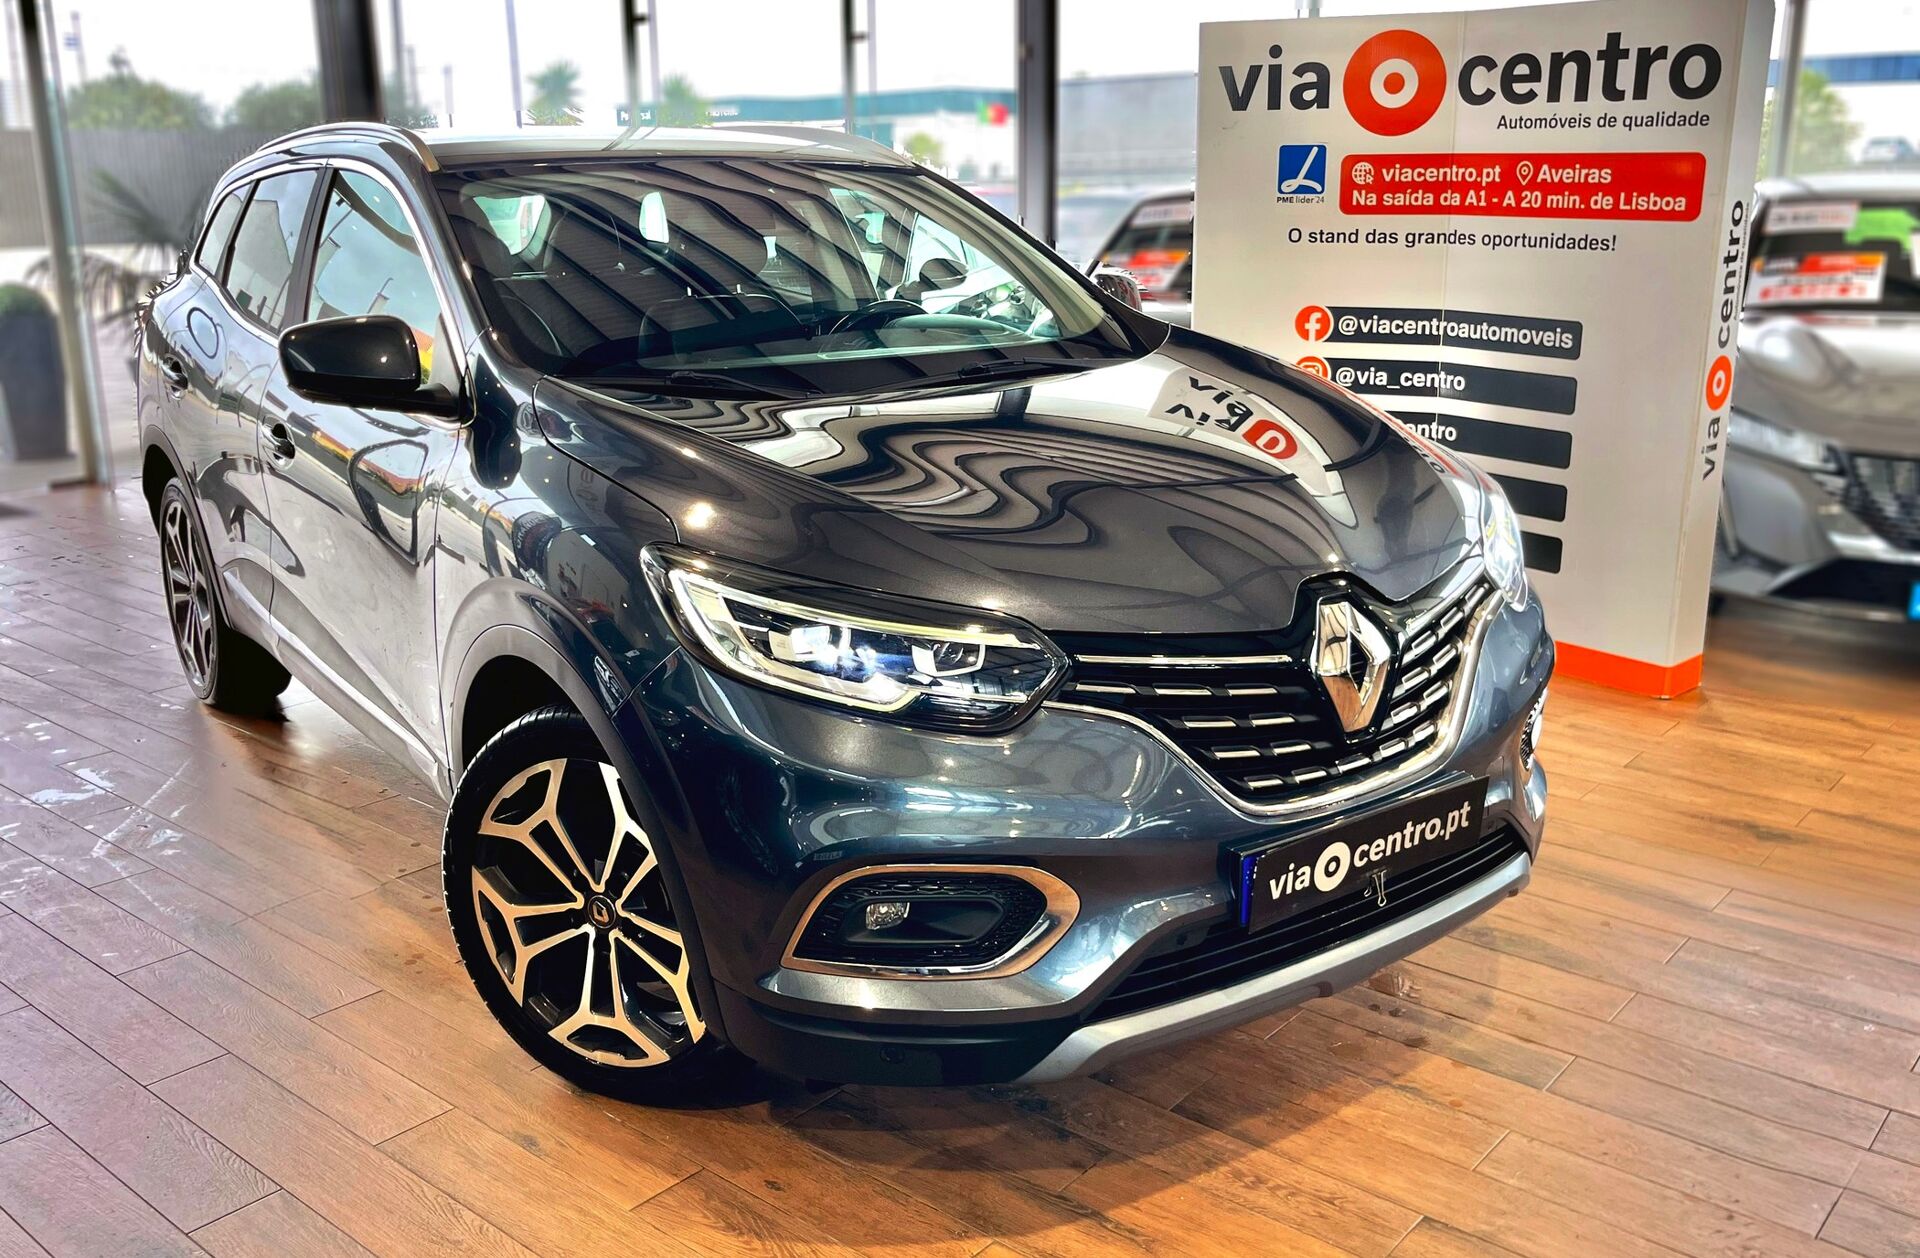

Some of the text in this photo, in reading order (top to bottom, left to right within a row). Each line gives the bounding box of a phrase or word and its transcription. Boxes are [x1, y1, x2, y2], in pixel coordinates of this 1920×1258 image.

[1218, 31, 1722, 111] via centro
[1496, 111, 1710, 131] Automóveis de qualidade
[1381, 163, 1613, 187] viacentro.pt Aveiras
[1276, 196, 1295, 204] PME
[1351, 189, 1377, 206] Na
[1382, 188, 1434, 206] saída
[1439, 189, 1461, 206] da
[1464, 189, 1487, 207] A1
[1502, 190, 1517, 208] A
[1520, 190, 1542, 208] 20
[1546, 191, 1585, 209] min.
[1589, 192, 1613, 210] de
[1618, 192, 1687, 211] Lisboa
[1288, 227, 1617, 251] O stand das grandes oportunidades!
[1337, 315, 1574, 349] @viacentroautomoveis
[1702, 200, 1744, 481] via centro
[1336, 366, 1466, 391] @via_centro
[1268, 801, 1471, 900] via centro.pt
